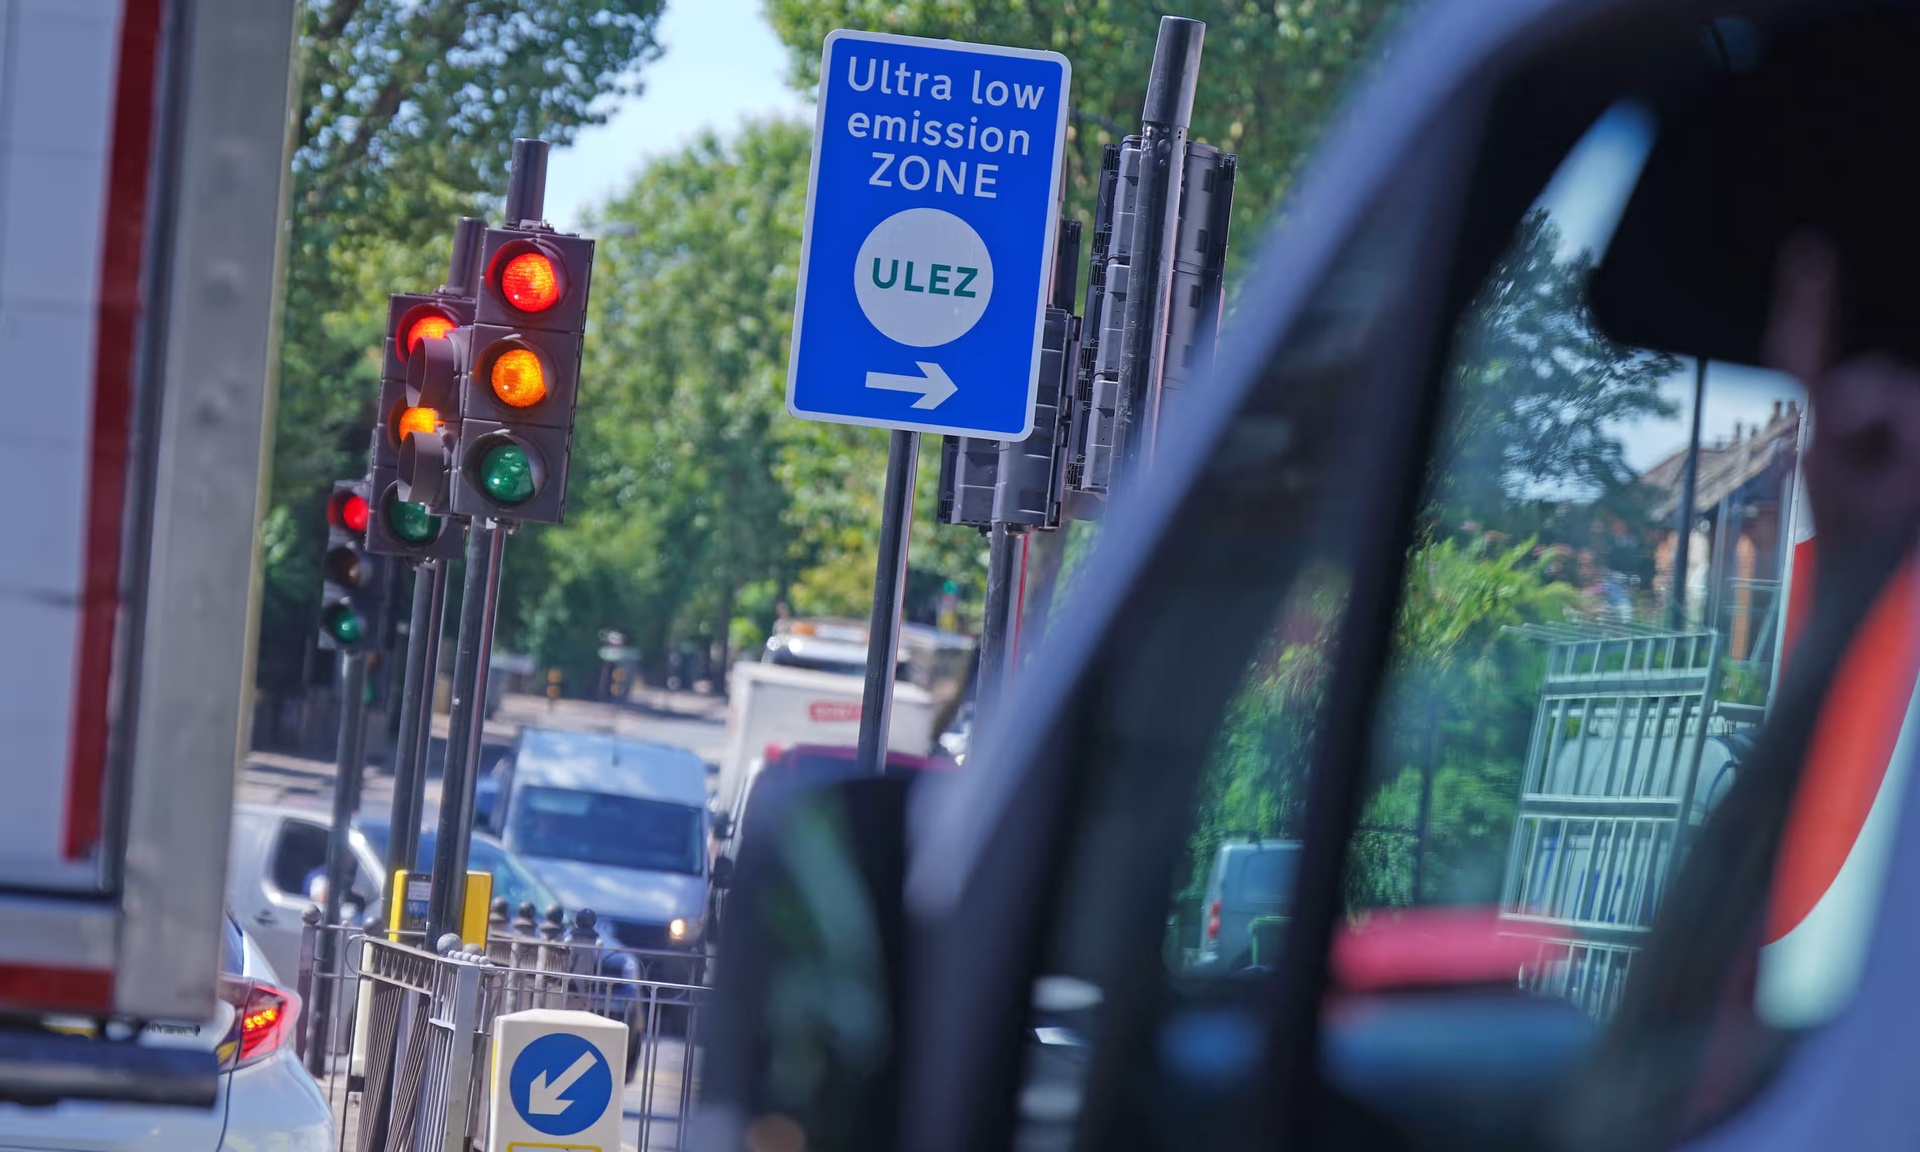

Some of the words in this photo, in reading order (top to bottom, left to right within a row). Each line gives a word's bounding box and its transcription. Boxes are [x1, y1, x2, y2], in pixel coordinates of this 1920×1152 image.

[848, 56, 952, 101] Ultra
[972, 70, 1045, 110] low
[848, 110, 1030, 156] emission
[869, 152, 999, 198] ZONE
[872, 257, 978, 298] ULEZ
